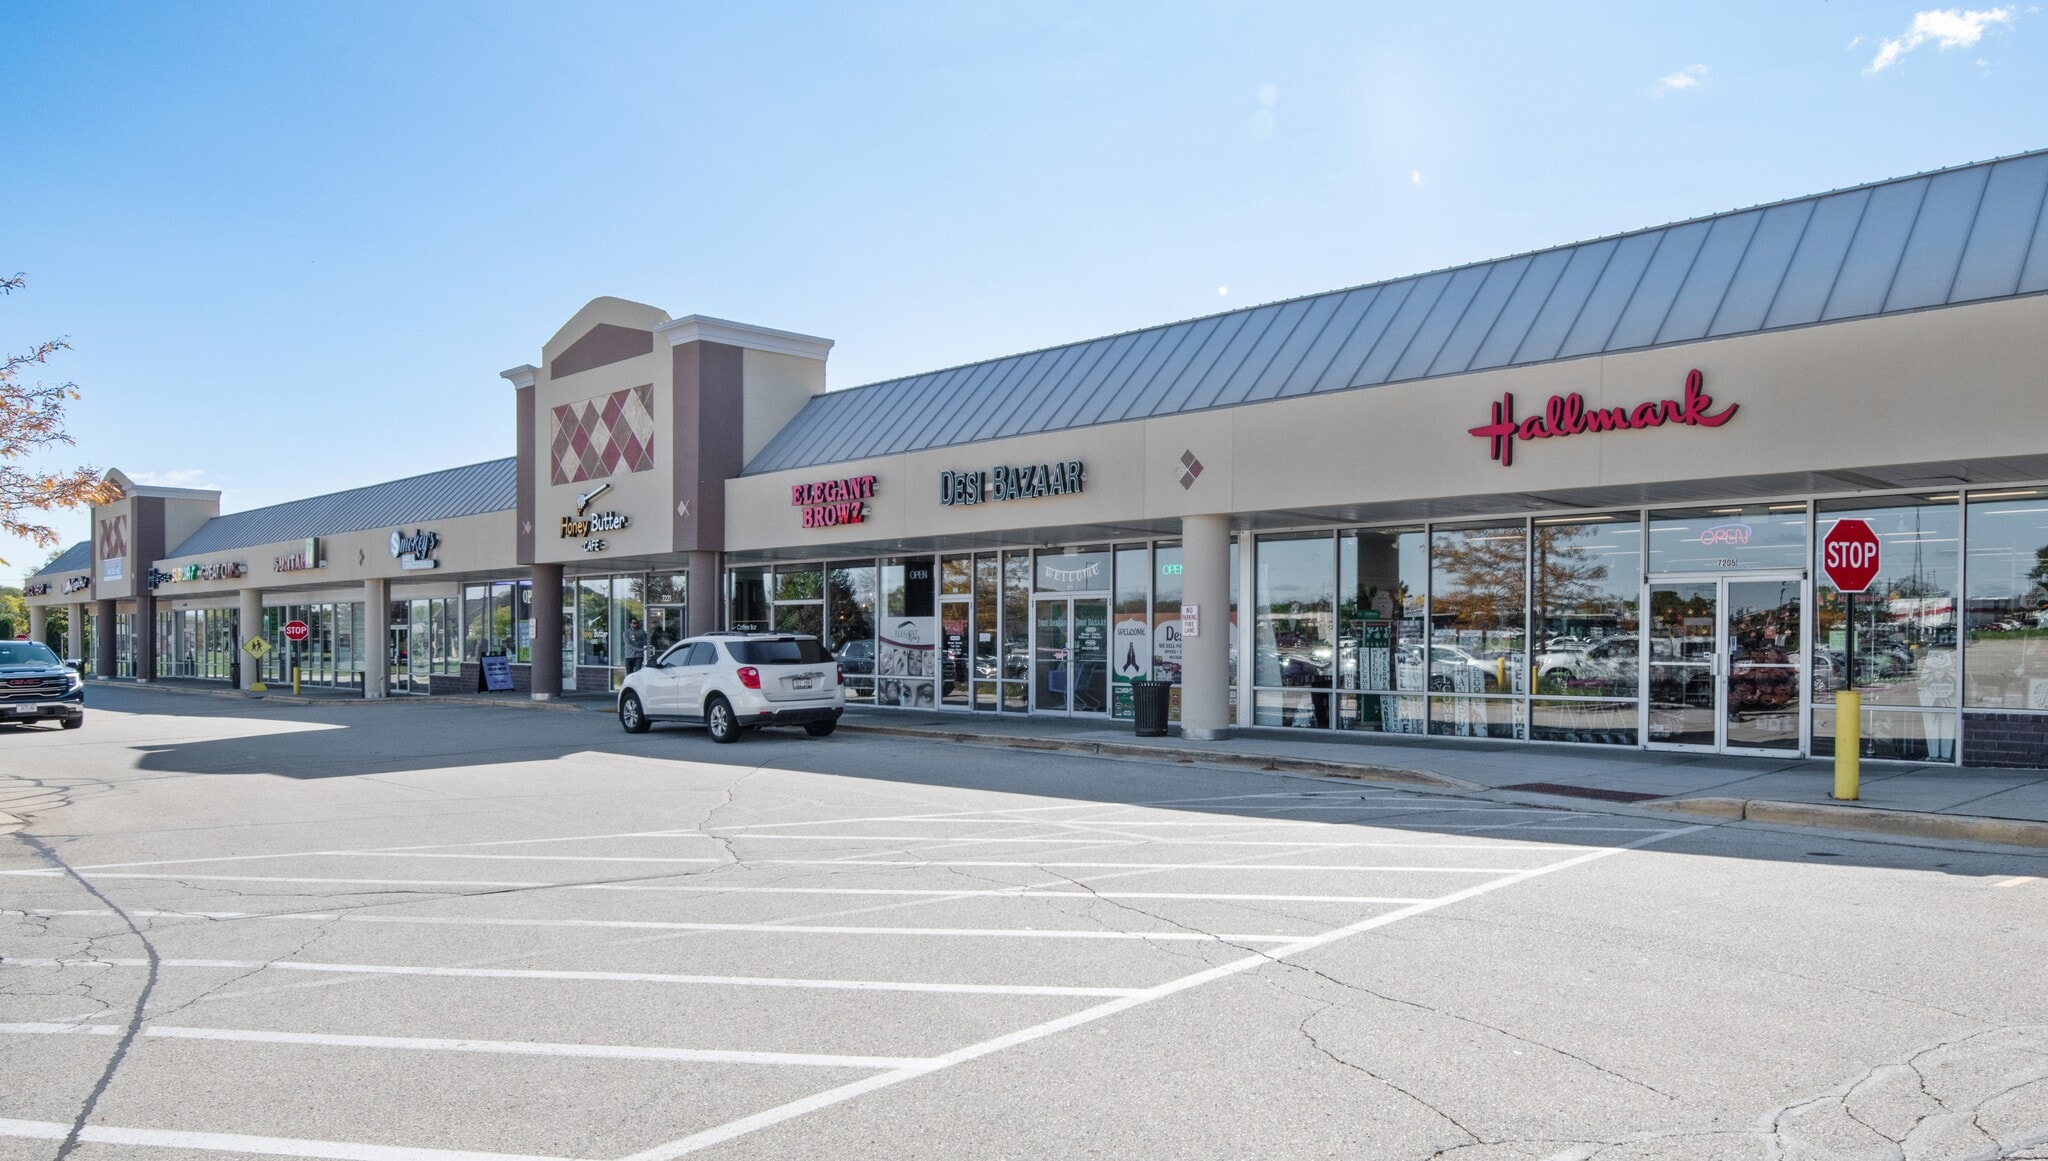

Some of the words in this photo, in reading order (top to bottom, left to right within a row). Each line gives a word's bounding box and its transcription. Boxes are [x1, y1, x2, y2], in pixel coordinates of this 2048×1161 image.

[1468, 369, 1738, 466] Hallmark
[792, 475, 876, 506] ELEGANT
[940, 470, 985, 506] DESI
[992, 459, 1083, 501] BAZAAR
[561, 516, 590, 538] Honey
[591, 511, 628, 532] Butter
[802, 501, 864, 528] BROWZ
[583, 540, 601, 551] CAFE
[1700, 528, 1749, 545] OPEN
[1827, 541, 1877, 568] STOP
[909, 570, 928, 579] OPEN
[523, 590, 533, 604] OP
[286, 626, 307, 634] STOP
[1118, 628, 1146, 636] WELCOME
